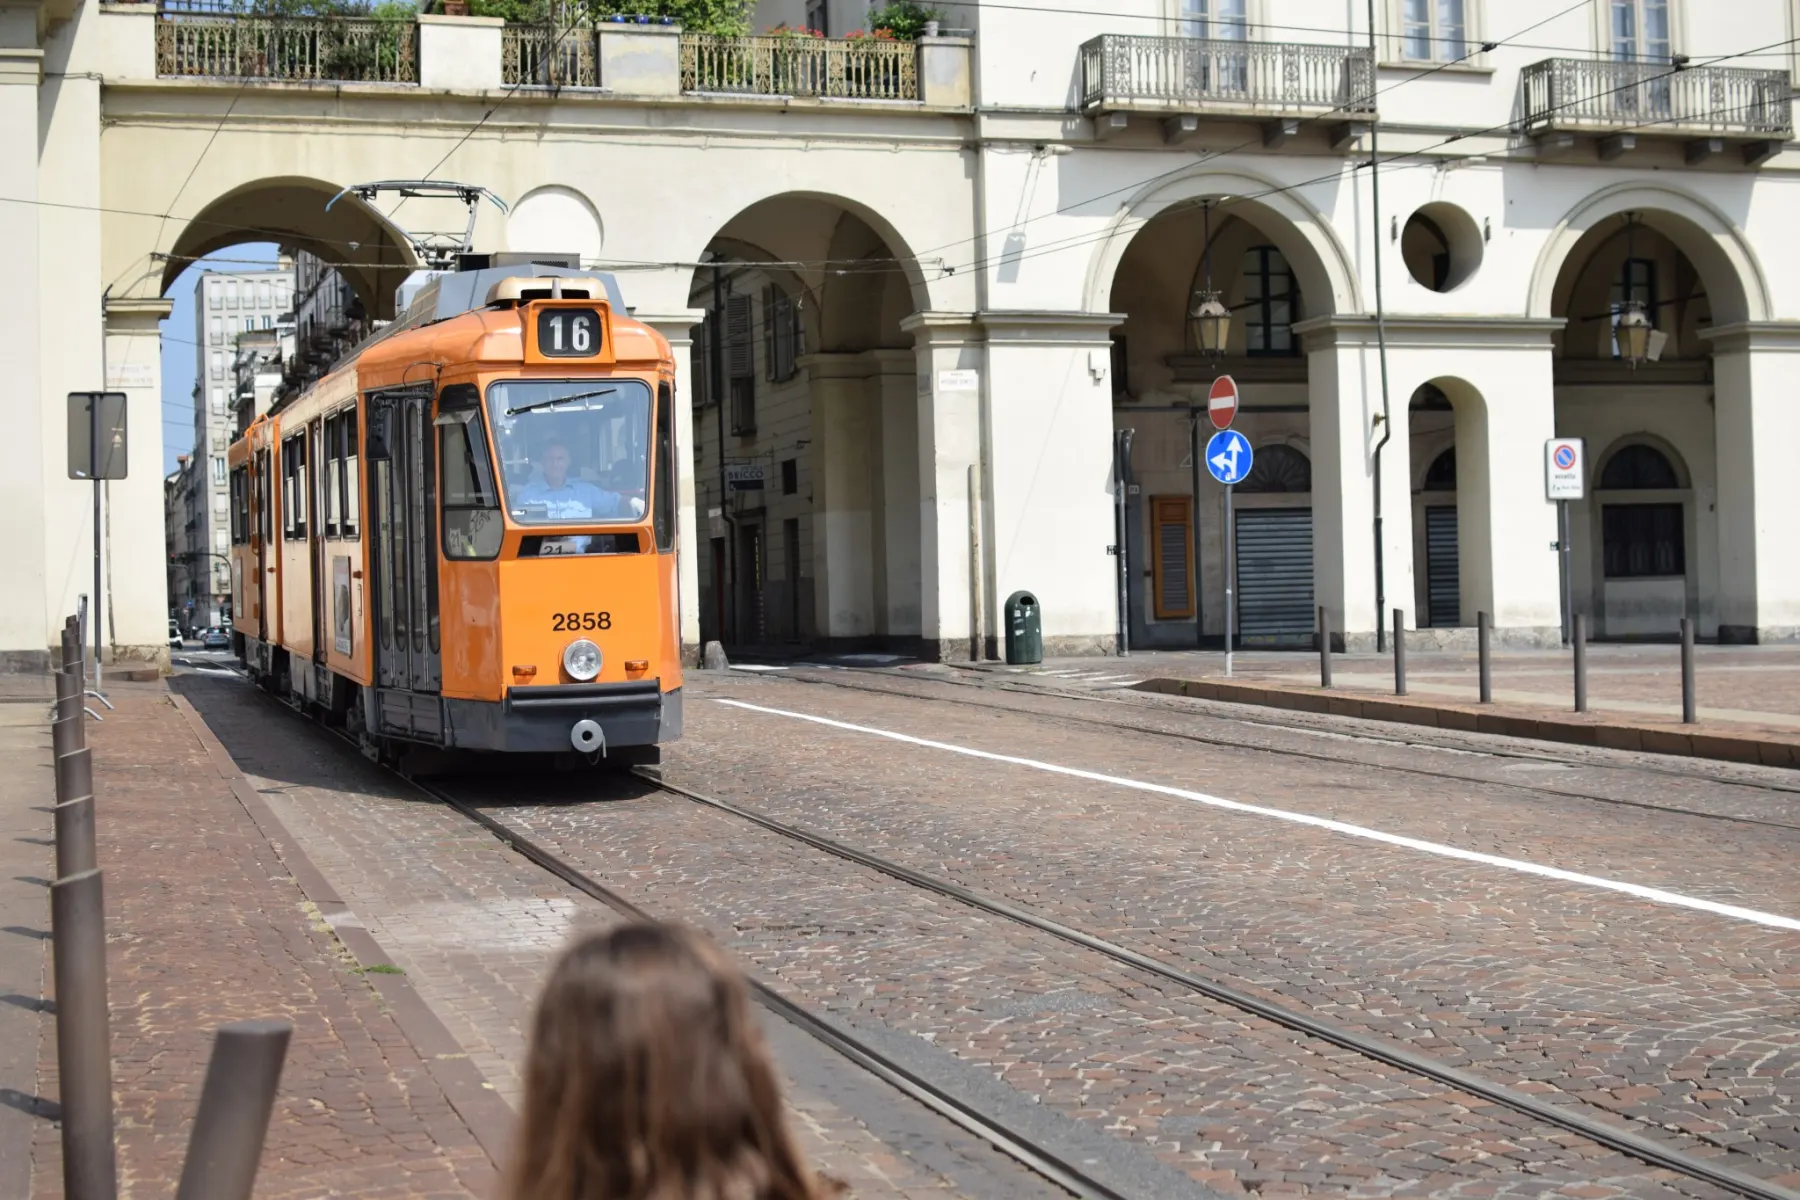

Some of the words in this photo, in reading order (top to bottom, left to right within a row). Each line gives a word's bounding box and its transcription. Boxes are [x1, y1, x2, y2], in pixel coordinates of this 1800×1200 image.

[549, 315, 590, 352] 16
[543, 544, 563, 554] 21
[551, 611, 612, 632] 2858
